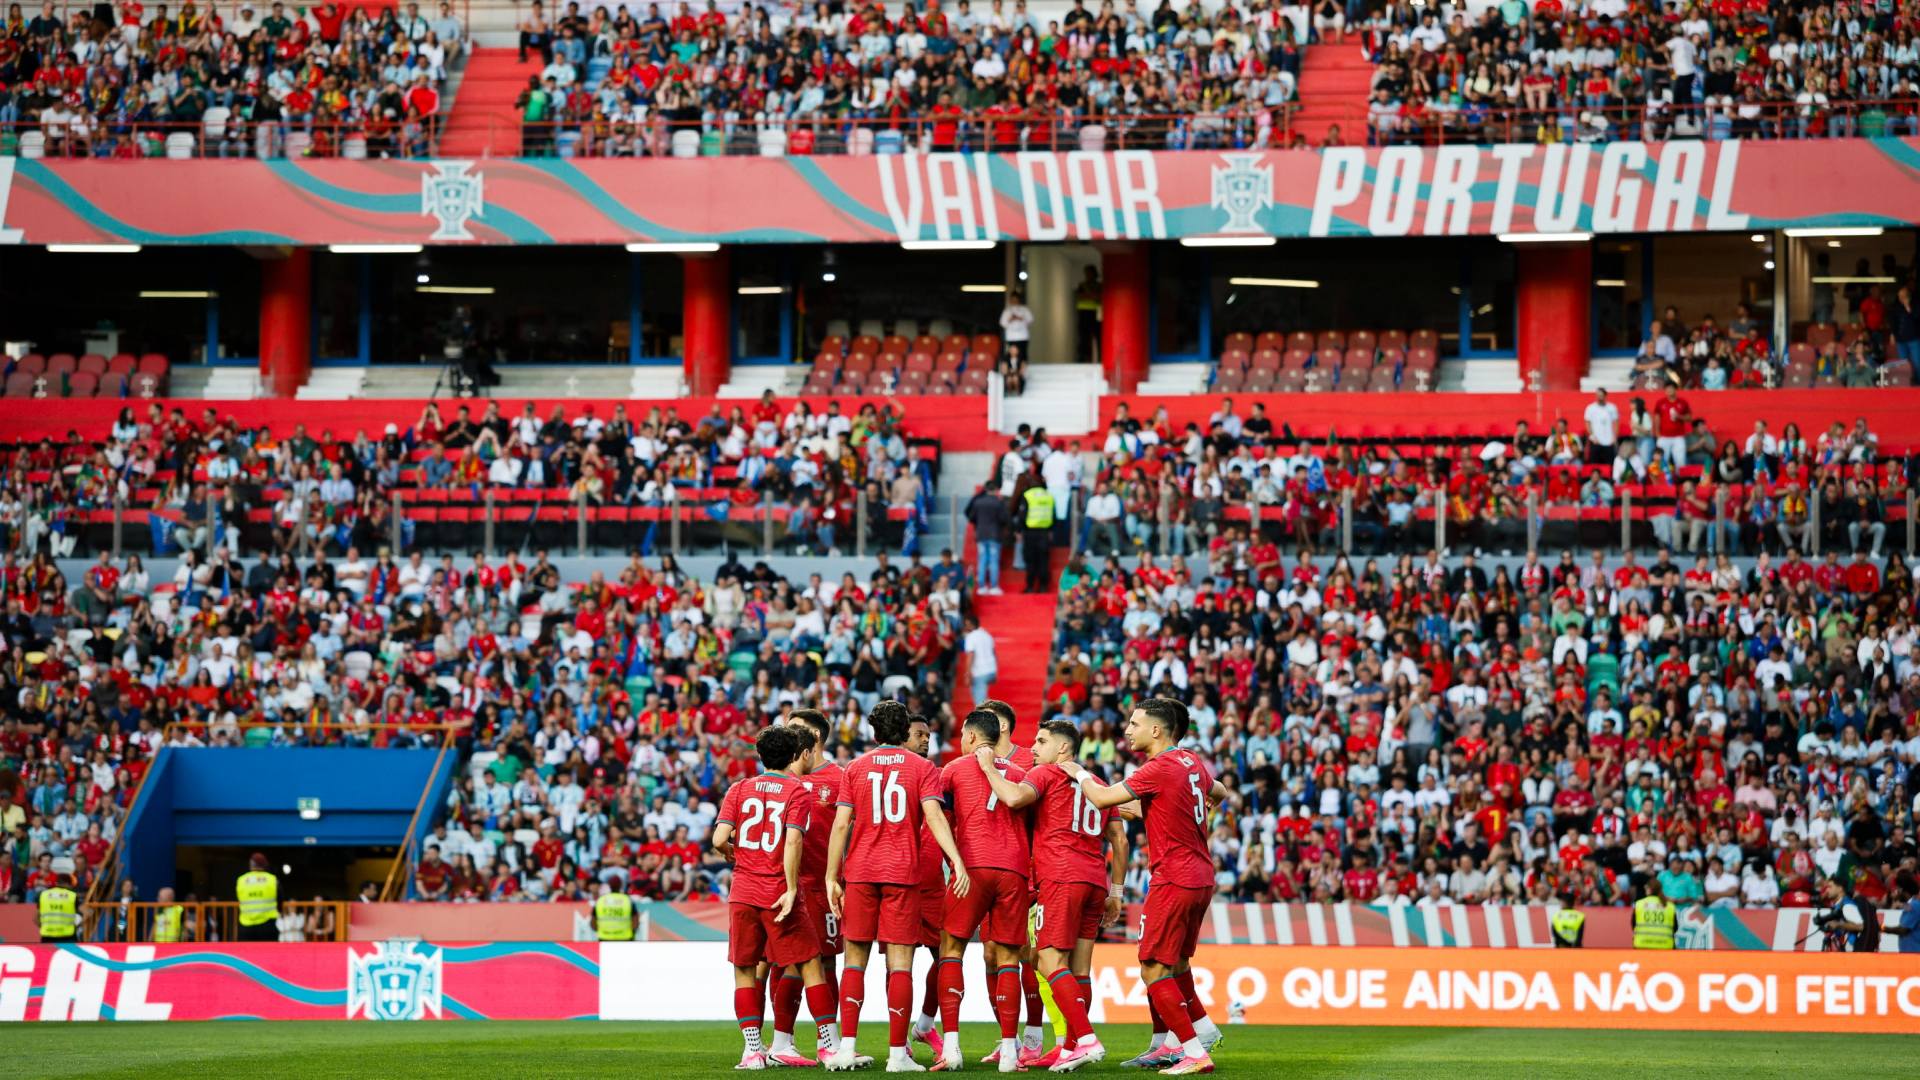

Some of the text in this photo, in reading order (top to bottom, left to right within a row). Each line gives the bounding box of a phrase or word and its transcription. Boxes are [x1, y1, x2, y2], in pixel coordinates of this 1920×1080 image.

[876, 139, 1751, 240] VAI DAR PORTUGAL
[755, 781, 783, 794] VITINHA
[867, 770, 907, 824] 16
[1188, 772, 1204, 825] 5
[738, 797, 786, 853] 23
[825, 912, 838, 938] 8
[1137, 913, 1147, 940] 5
[0, 945, 173, 1021] GAL
[1226, 966, 1267, 1008] O
[1282, 967, 1388, 1009] QUE
[1402, 969, 1561, 1011] AINDA
[1573, 961, 1685, 1013] NÃO
[1698, 972, 1777, 1014] FOI
[1796, 974, 1920, 1017] FEITO
